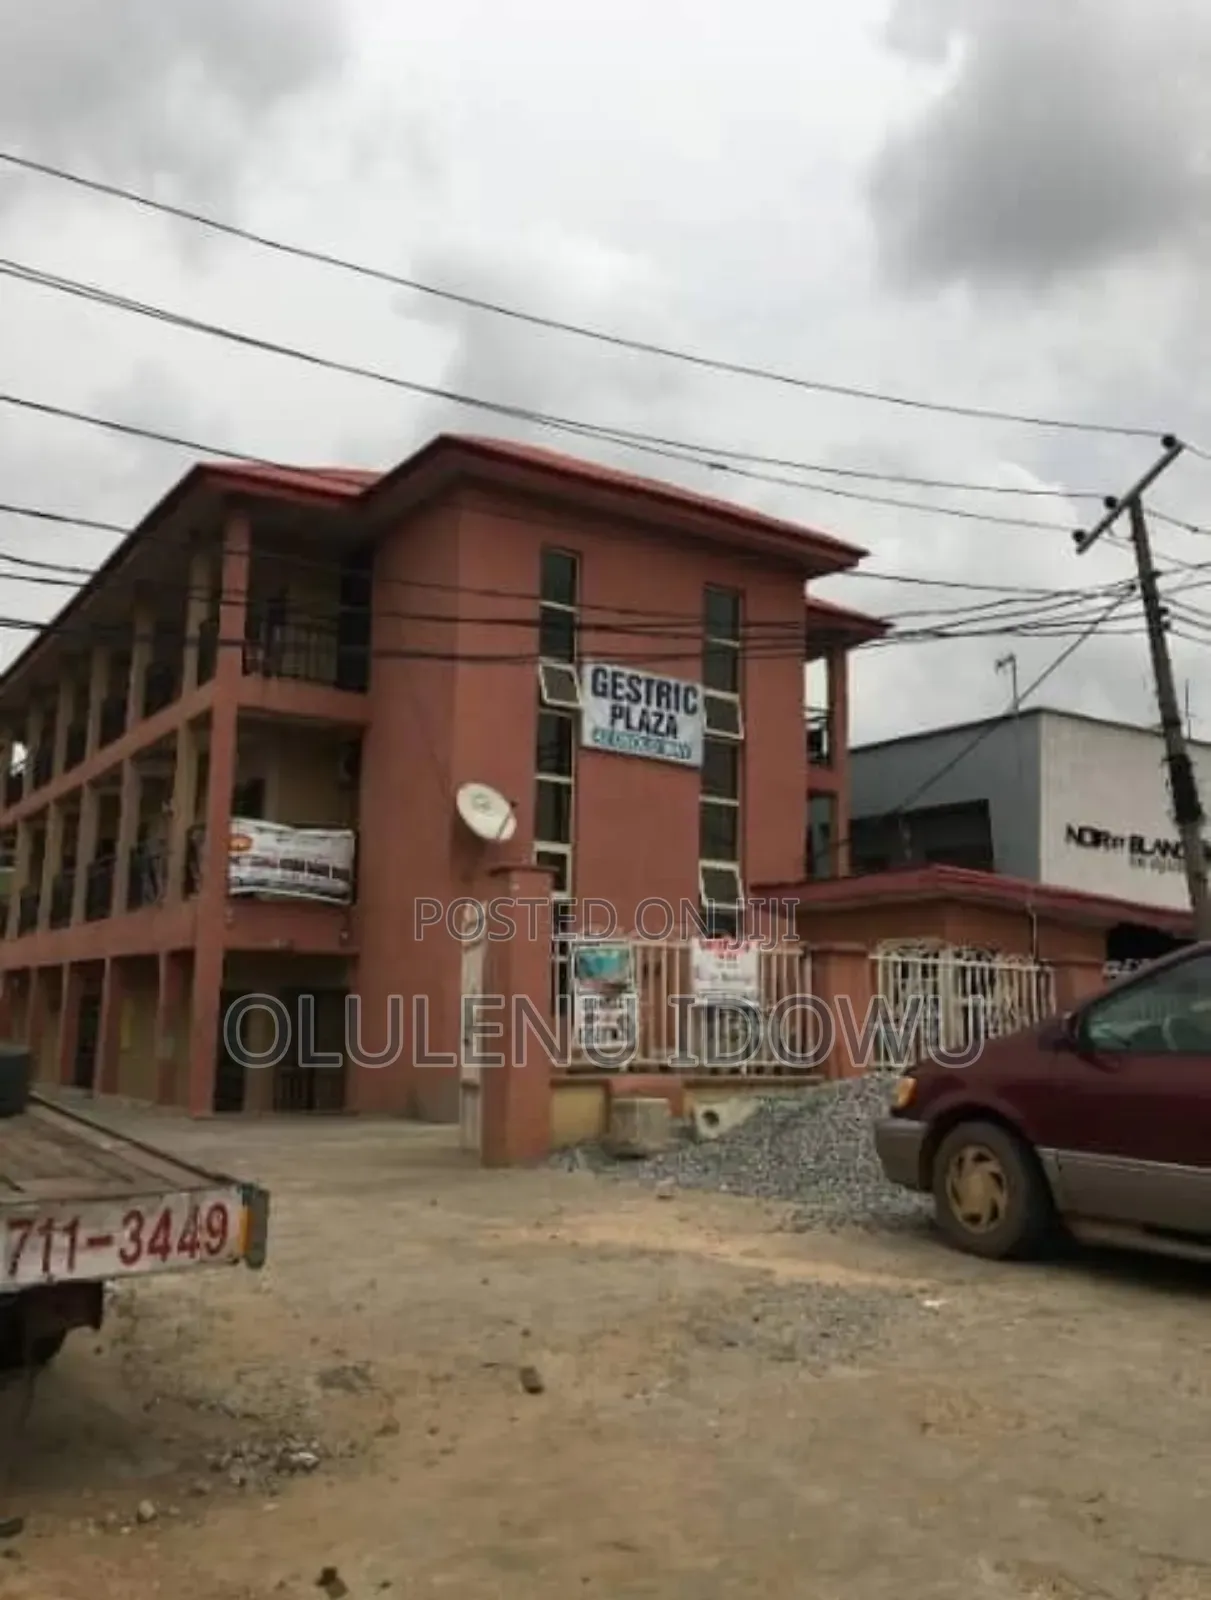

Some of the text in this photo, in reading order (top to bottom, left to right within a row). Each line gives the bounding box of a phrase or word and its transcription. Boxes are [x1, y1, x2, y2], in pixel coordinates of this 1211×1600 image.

[591, 667, 698, 715] GESTRIC
[610, 703, 677, 739] PLAZA
[7, 1202, 229, 1276] 711-3449
